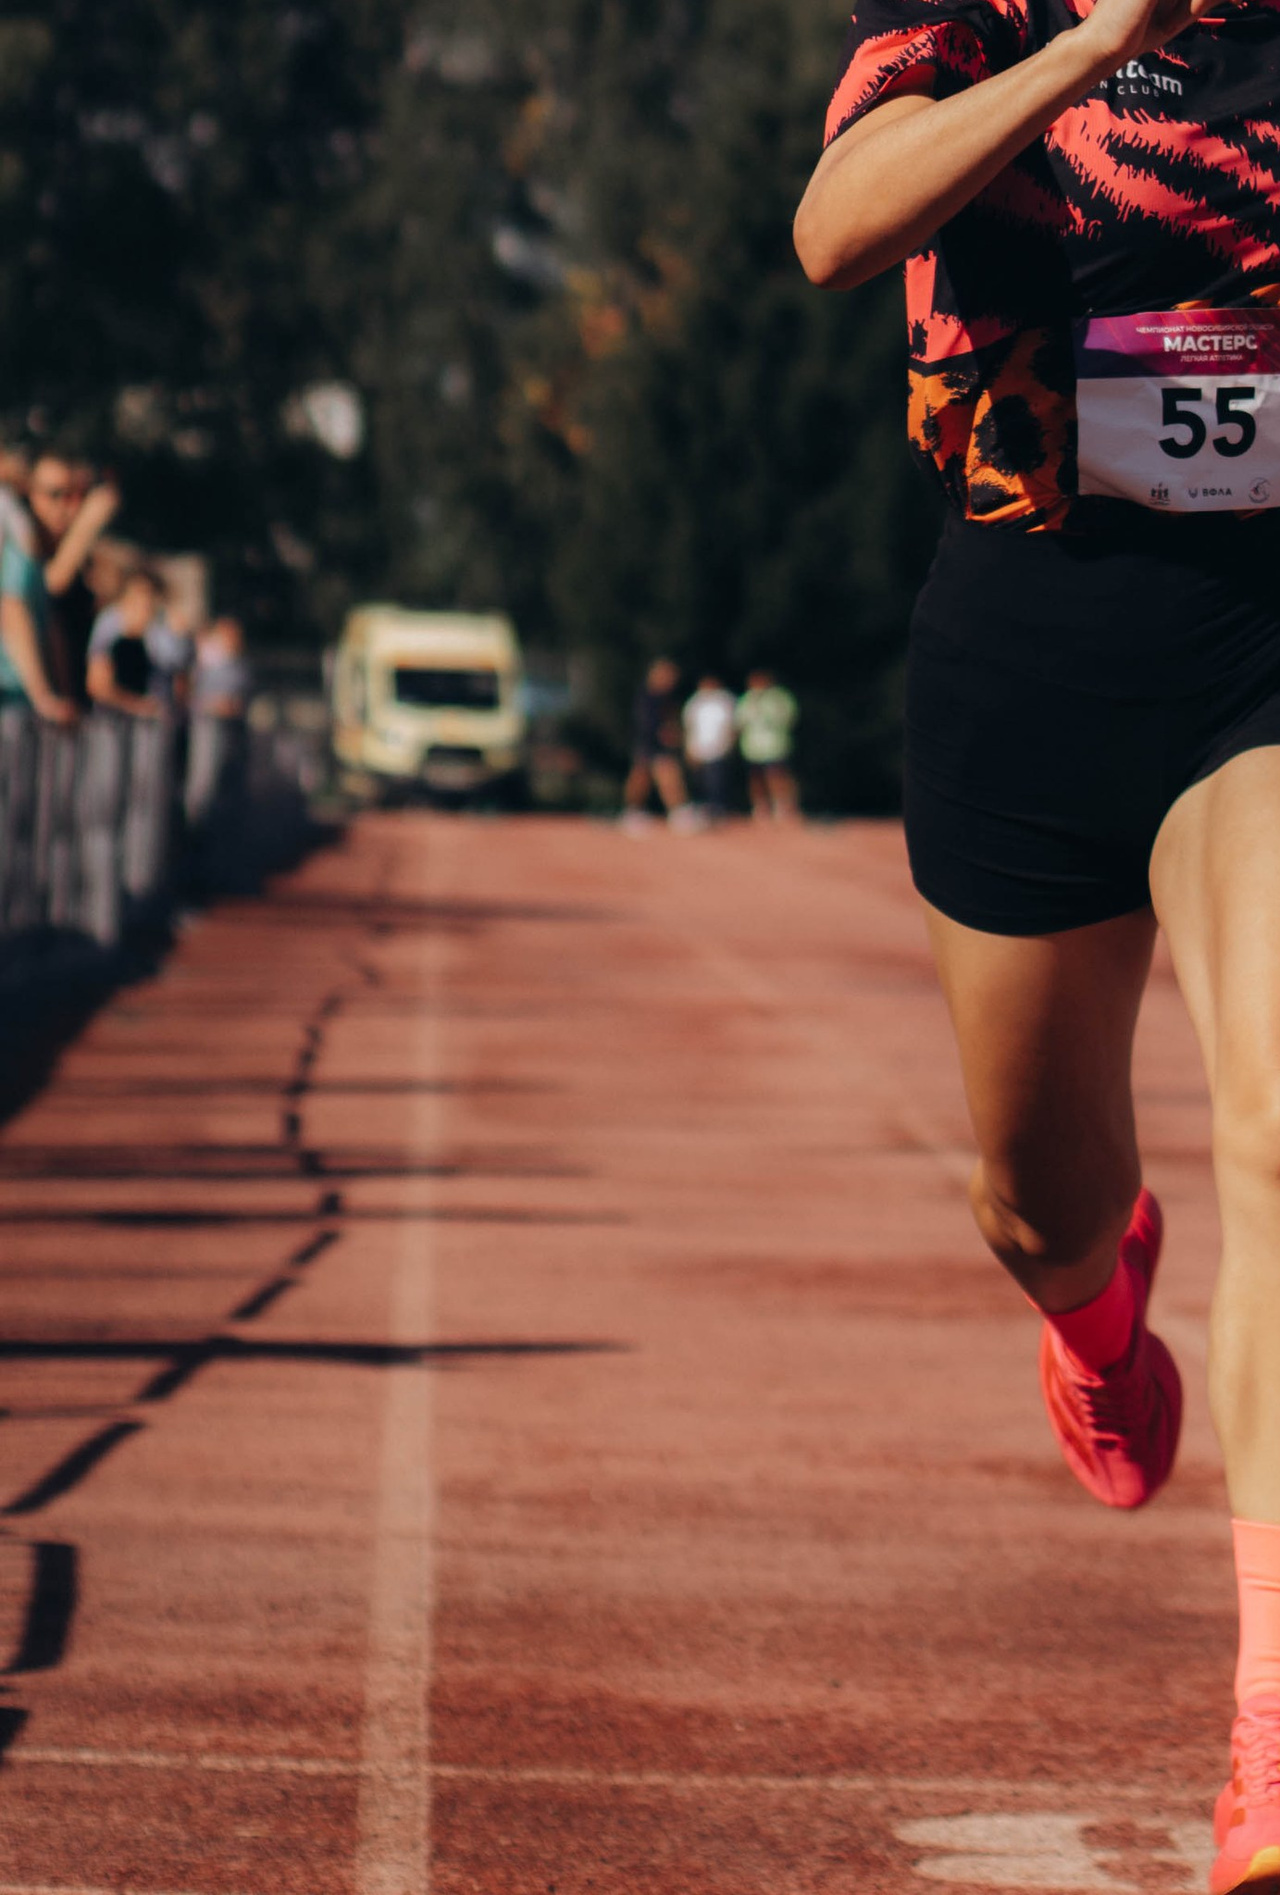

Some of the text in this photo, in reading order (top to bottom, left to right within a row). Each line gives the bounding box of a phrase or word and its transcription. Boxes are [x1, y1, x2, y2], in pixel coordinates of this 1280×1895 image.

[1117, 84, 1160, 98] CLUB
[1163, 334, 1258, 352] МАСТЕРС
[1158, 386, 1257, 459] 55
